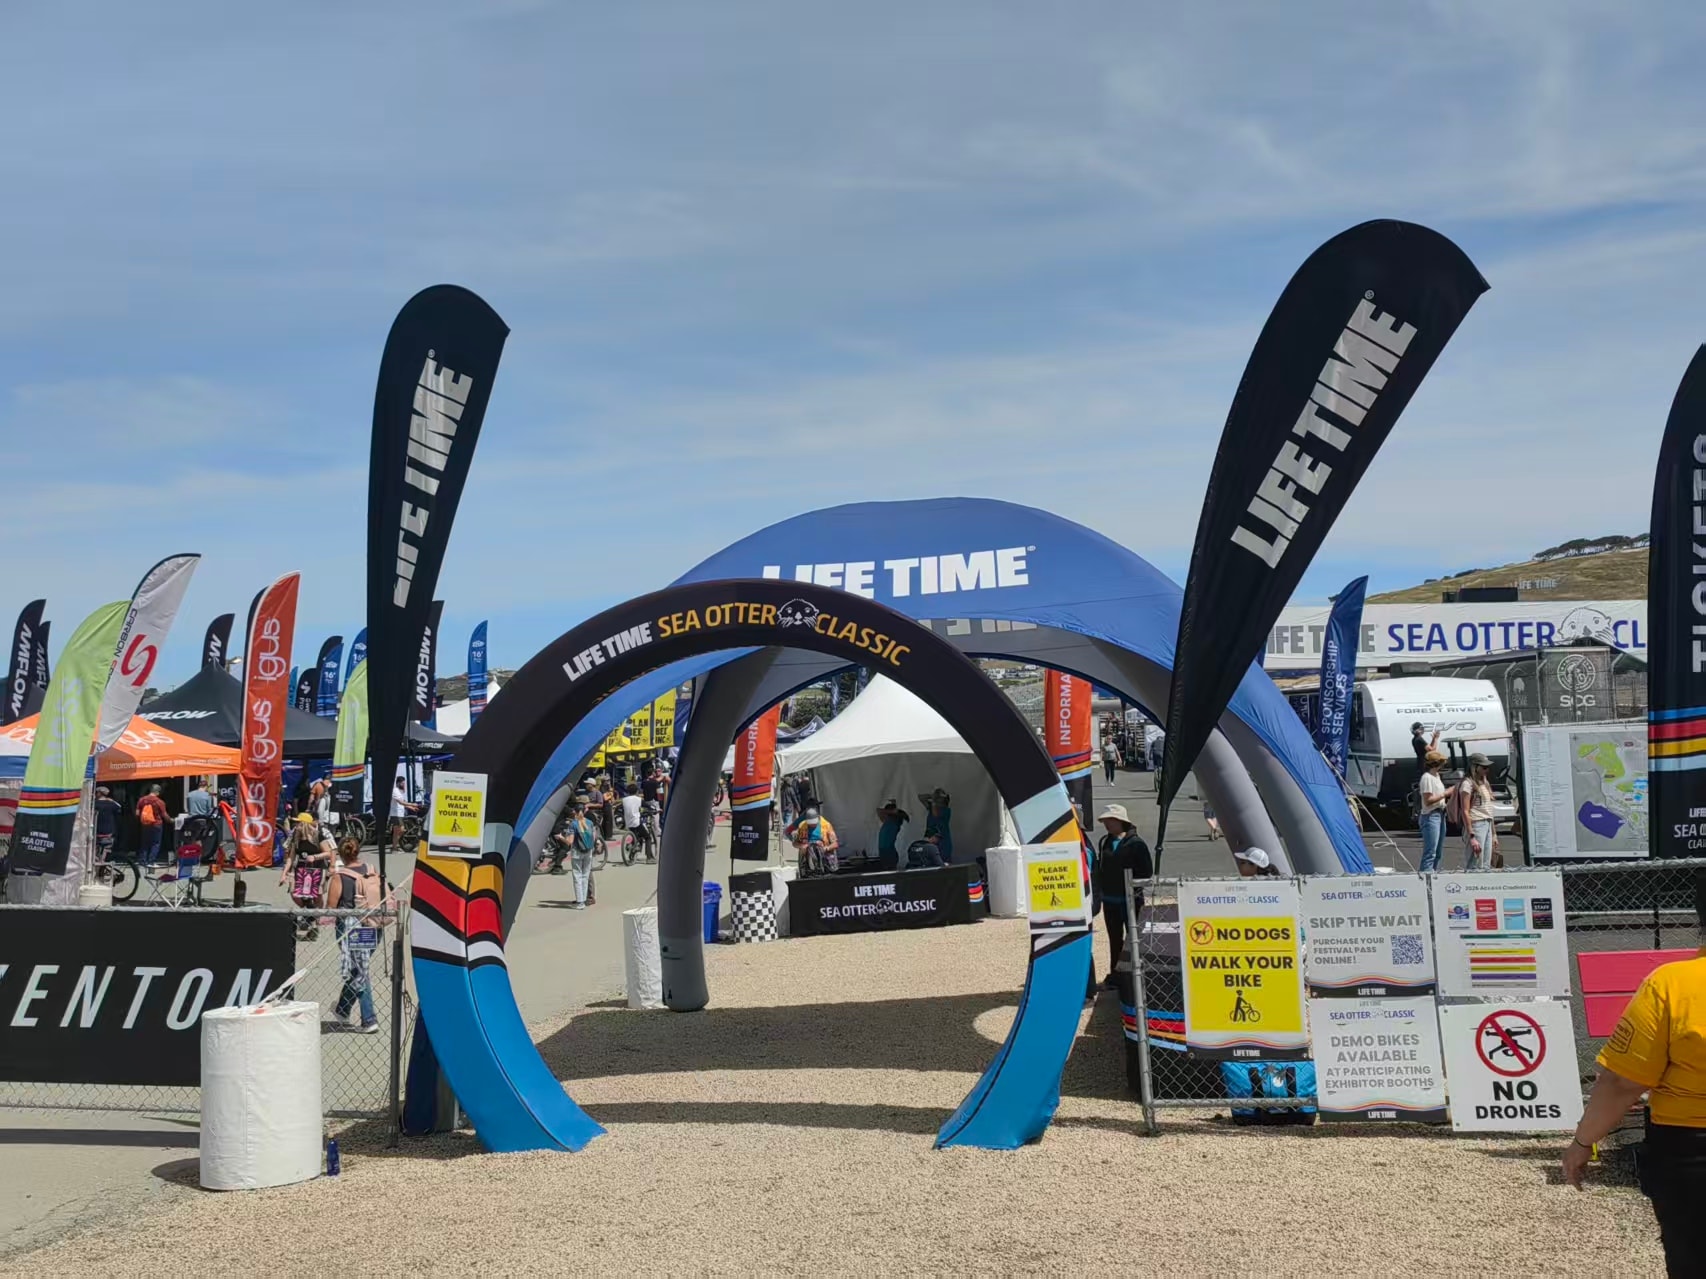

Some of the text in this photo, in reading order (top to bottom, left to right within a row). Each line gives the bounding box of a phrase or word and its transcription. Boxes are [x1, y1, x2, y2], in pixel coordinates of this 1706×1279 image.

[1230, 298, 1418, 569] LIFE TIME
[884, 546, 1029, 598] TIME
[562, 643, 605, 682] LIFE
[601, 621, 653, 658] TIME
[658, 609, 701, 638] SEA
[706, 603, 776, 628] OTTER
[815, 613, 911, 666] CLASSIC
[1267, 625, 1304, 654] IFE
[1308, 624, 1375, 654] TE
[1388, 623, 1448, 652] SEA
[1456, 620, 1555, 651] OTTER
[253, 618, 287, 680] igus
[416, 626, 431, 708] AMFLOW
[1322, 640, 1338, 734] SPONSORSHIP
[1060, 672, 1072, 745] INFORMA
[1332, 673, 1347, 735] SERVICES
[139, 710, 217, 721] MFLOW
[248, 699, 278, 764] igus
[747, 718, 760, 776] INFORM
[1674, 824, 1697, 838] SEA
[1038, 866, 1068, 874] PLEASE
[854, 884, 896, 898] LIFE TIME
[1033, 883, 1056, 891] YOUR
[1197, 895, 1279, 904] SEA OTTER CLASSIC
[1321, 889, 1407, 900] SEA OTTER CLASSIC
[820, 899, 936, 918] SEA OTTER CLASSIC
[1310, 914, 1422, 928] SKIP THE WAIT
[1217, 928, 1290, 940] NO DOGS
[1313, 936, 1385, 946] PURCHASE YOUR
[1313, 947, 1353, 955] FESTIVAL
[1191, 956, 1293, 969] WALK YOUR
[1315, 956, 1357, 965] ONLINE!
[1224, 974, 1262, 987] BIKE
[0, 964, 272, 1031] ENTON
[1330, 1009, 1415, 1020] SEA OTTER CLASSIC
[1331, 1034, 1420, 1047] DEMO BIKES
[1337, 1049, 1417, 1062] AVAILABLE
[1327, 1066, 1431, 1077] AT PARTICIPATING
[1325, 1078, 1434, 1089] EXHIBITOR BOOTHS
[1493, 1081, 1538, 1101] NO
[1475, 1104, 1561, 1119] DRONES
